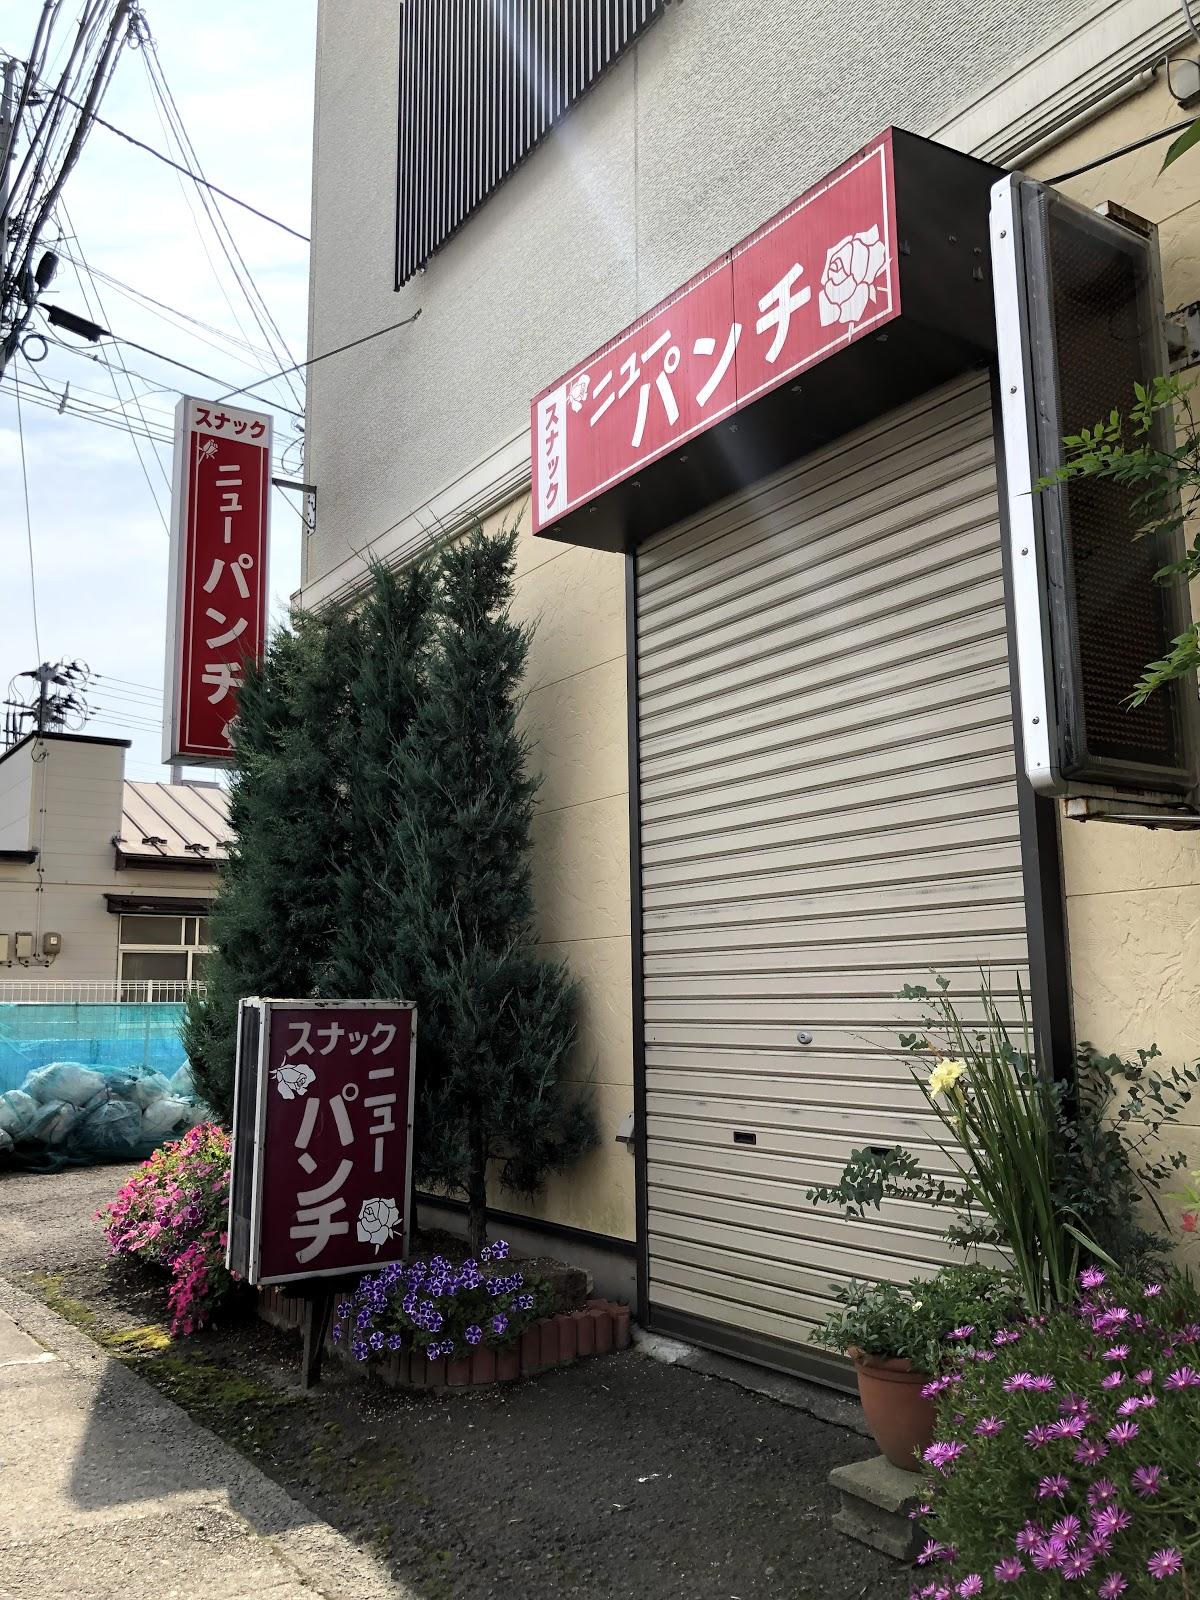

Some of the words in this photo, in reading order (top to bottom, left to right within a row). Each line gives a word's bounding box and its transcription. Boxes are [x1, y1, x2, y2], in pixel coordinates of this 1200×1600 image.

[632, 262, 811, 448] パンチ
[195, 407, 266, 439] スナック
[545, 404, 559, 510] スナック
[287, 1021, 397, 1056] スナック
[289, 1082, 359, 1264] パンチ
[364, 1067, 397, 1173] ニュー
